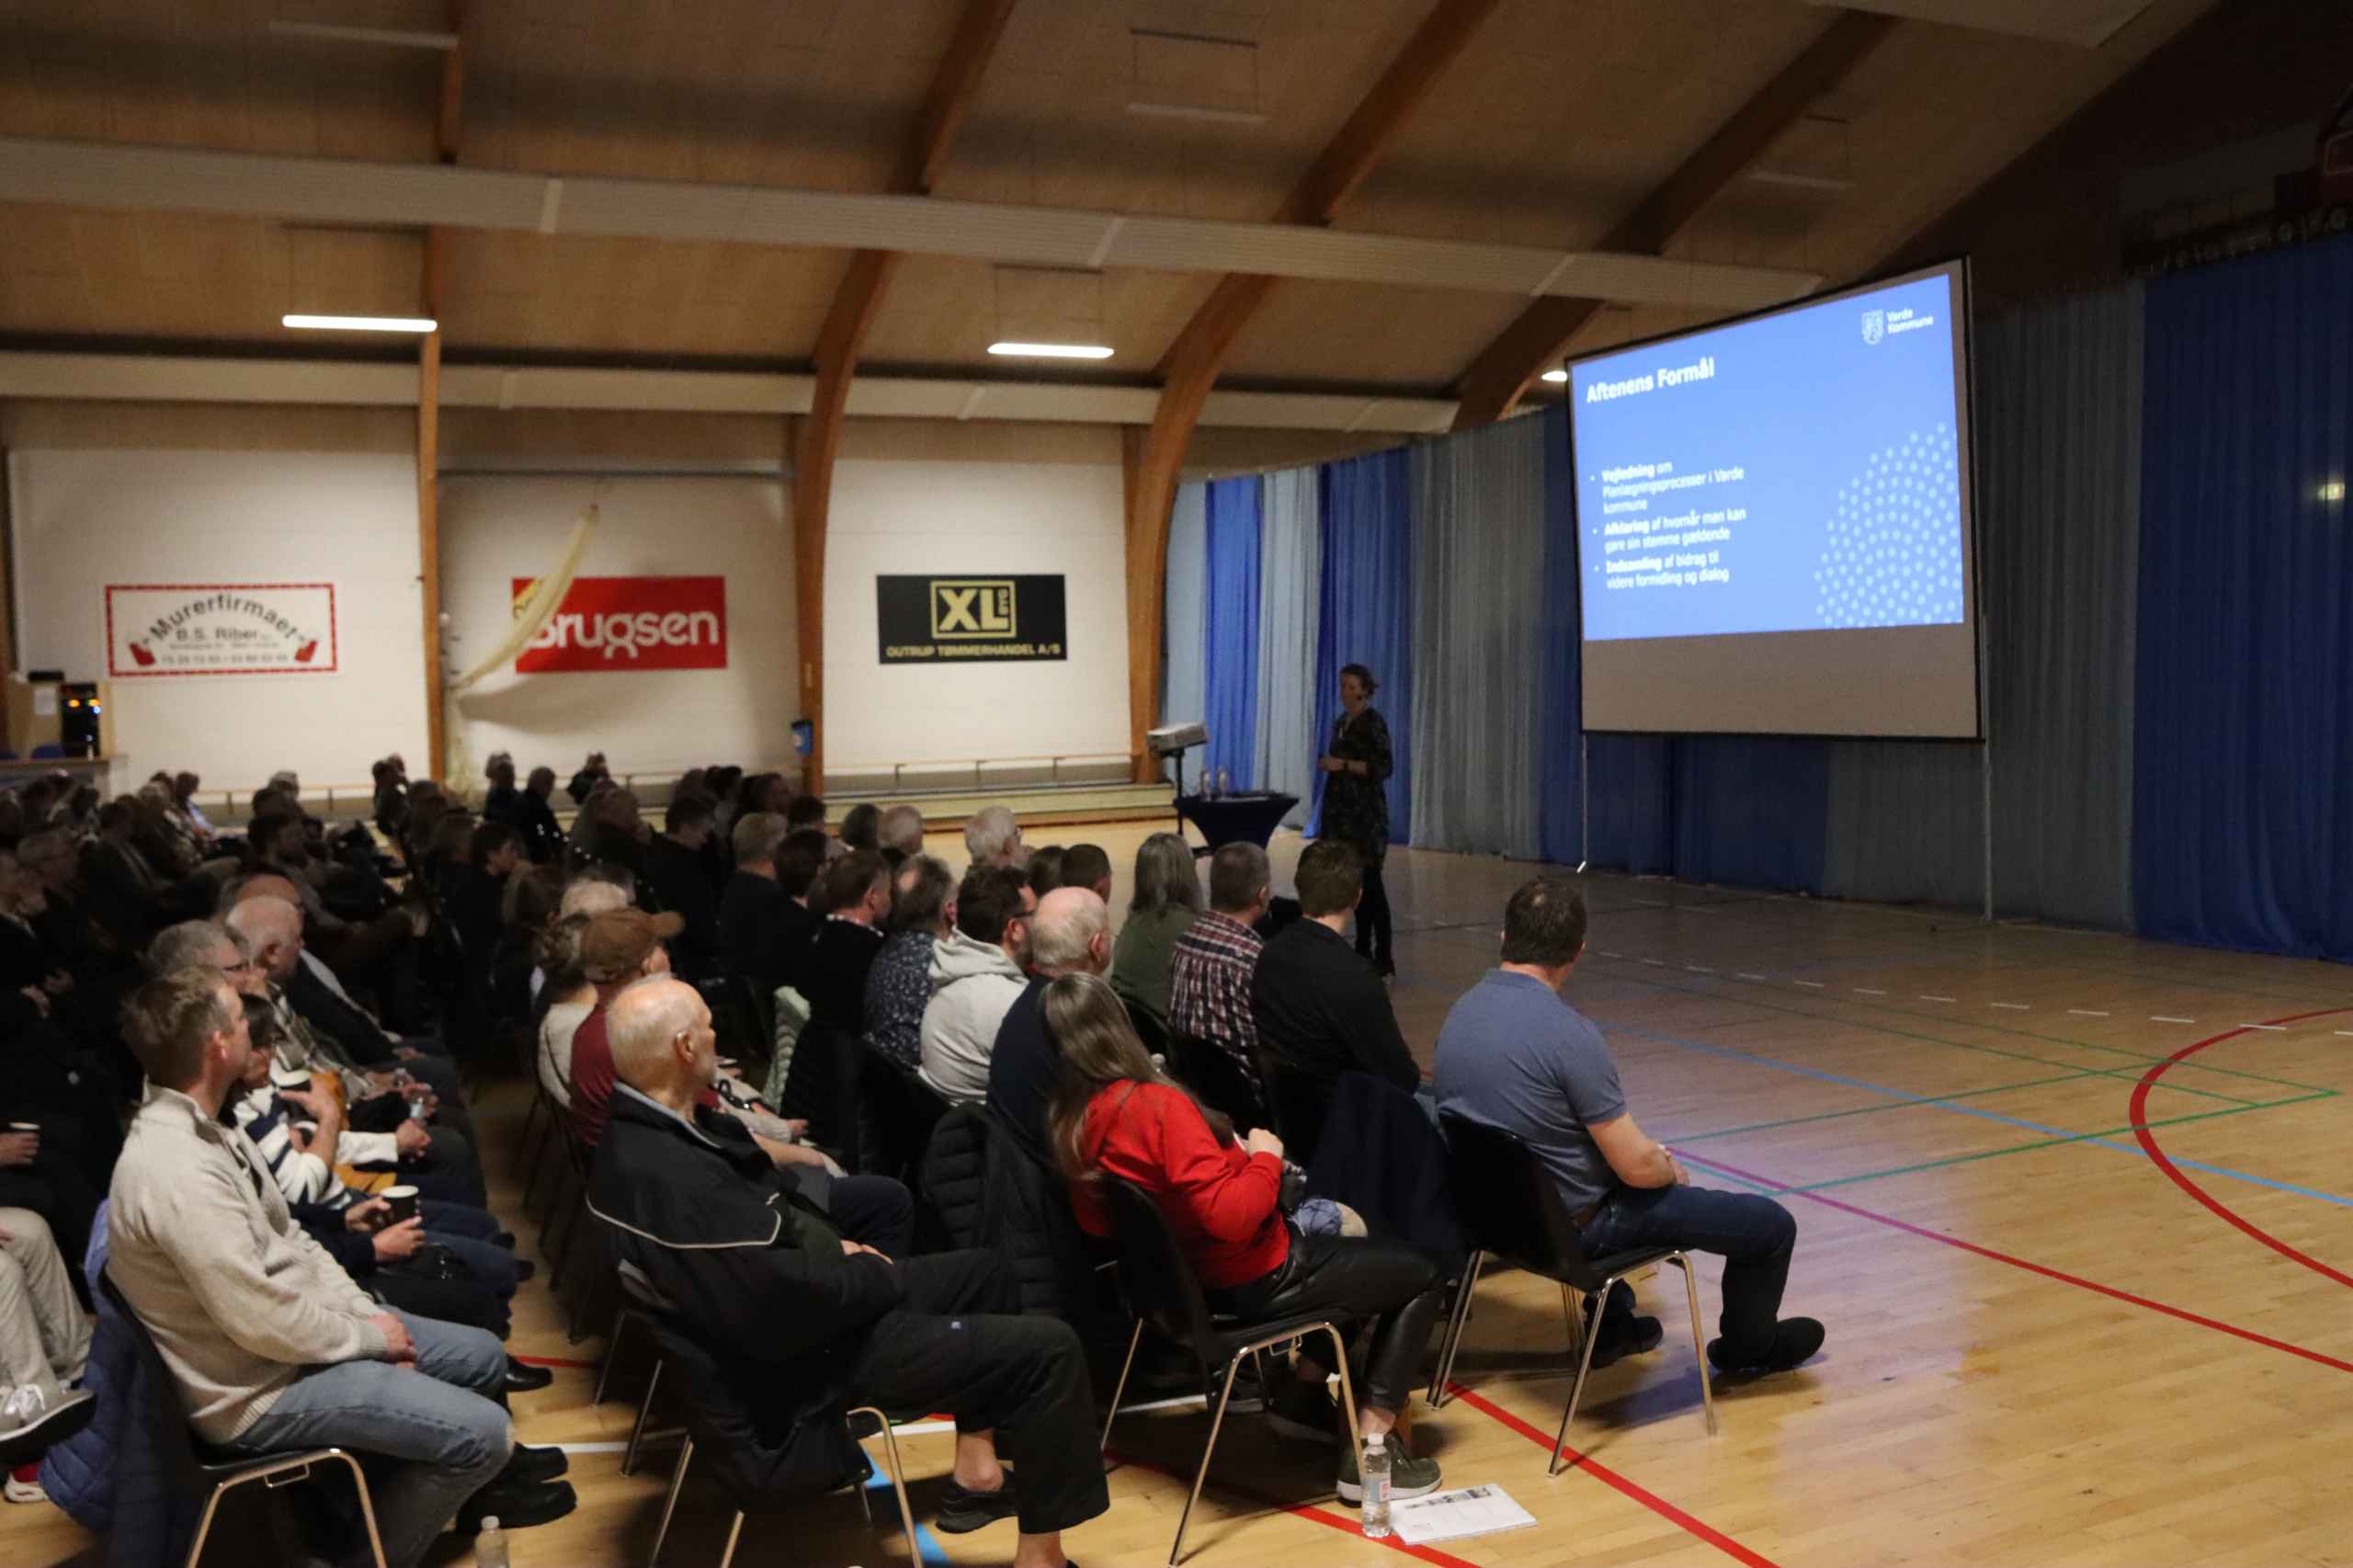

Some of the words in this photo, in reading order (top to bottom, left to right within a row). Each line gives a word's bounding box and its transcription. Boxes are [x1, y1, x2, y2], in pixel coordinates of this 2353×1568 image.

[1886, 308, 1914, 322] Varde
[1888, 317, 1934, 335] Kommune
[1586, 371, 1654, 403] Aftenens
[1657, 357, 1714, 390] Formål
[1713, 466, 1745, 483] Varde
[1701, 512, 1725, 524] man
[1726, 507, 1746, 521] kan
[1684, 571, 1698, 585] og
[1699, 567, 1730, 583] dialog
[938, 588, 1009, 631] XL
